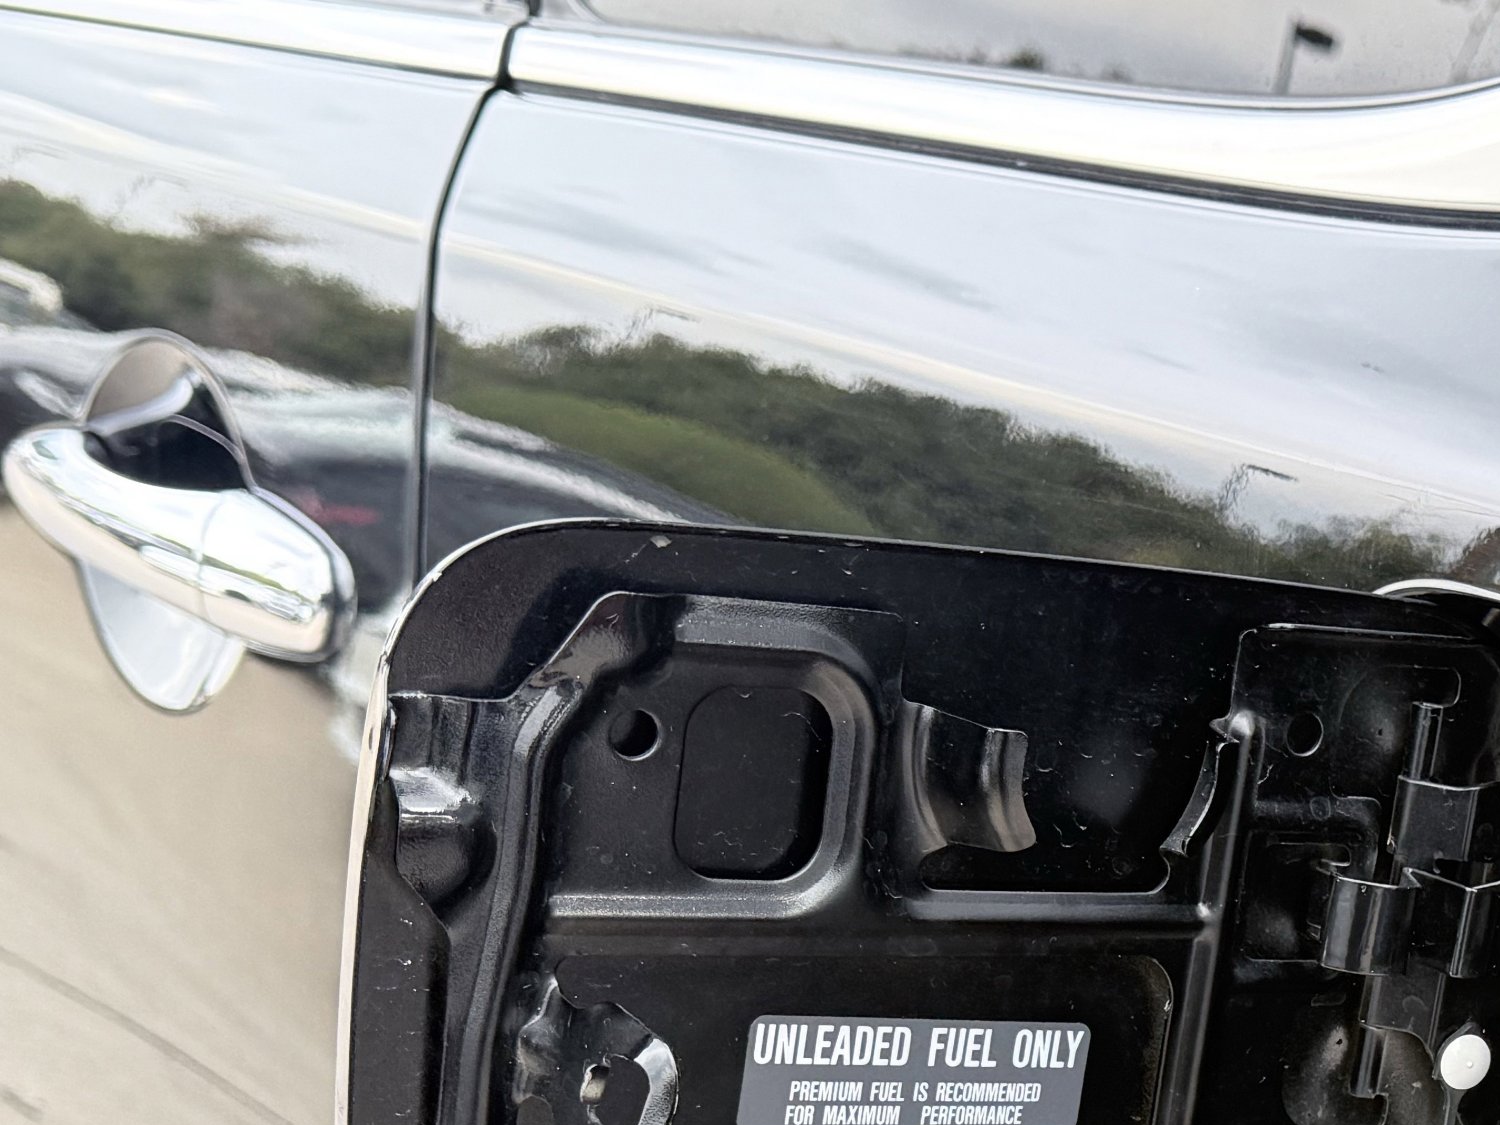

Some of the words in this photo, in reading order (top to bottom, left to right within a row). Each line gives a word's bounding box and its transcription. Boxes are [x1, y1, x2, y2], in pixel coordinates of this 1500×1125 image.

[753, 1023, 912, 1066] UNLEADED
[927, 1027, 997, 1068] FUEL
[1011, 1029, 1085, 1068] ONLY
[789, 1081, 863, 1102] PREMIUM
[869, 1081, 905, 1102] FUEL
[913, 1081, 928, 1102] IS
[935, 1082, 1041, 1103] RECOMMENDED
[784, 1105, 814, 1125] FOR
[822, 1105, 900, 1125] MAXIMUM
[920, 1105, 1023, 1125] PERFORMANCE
